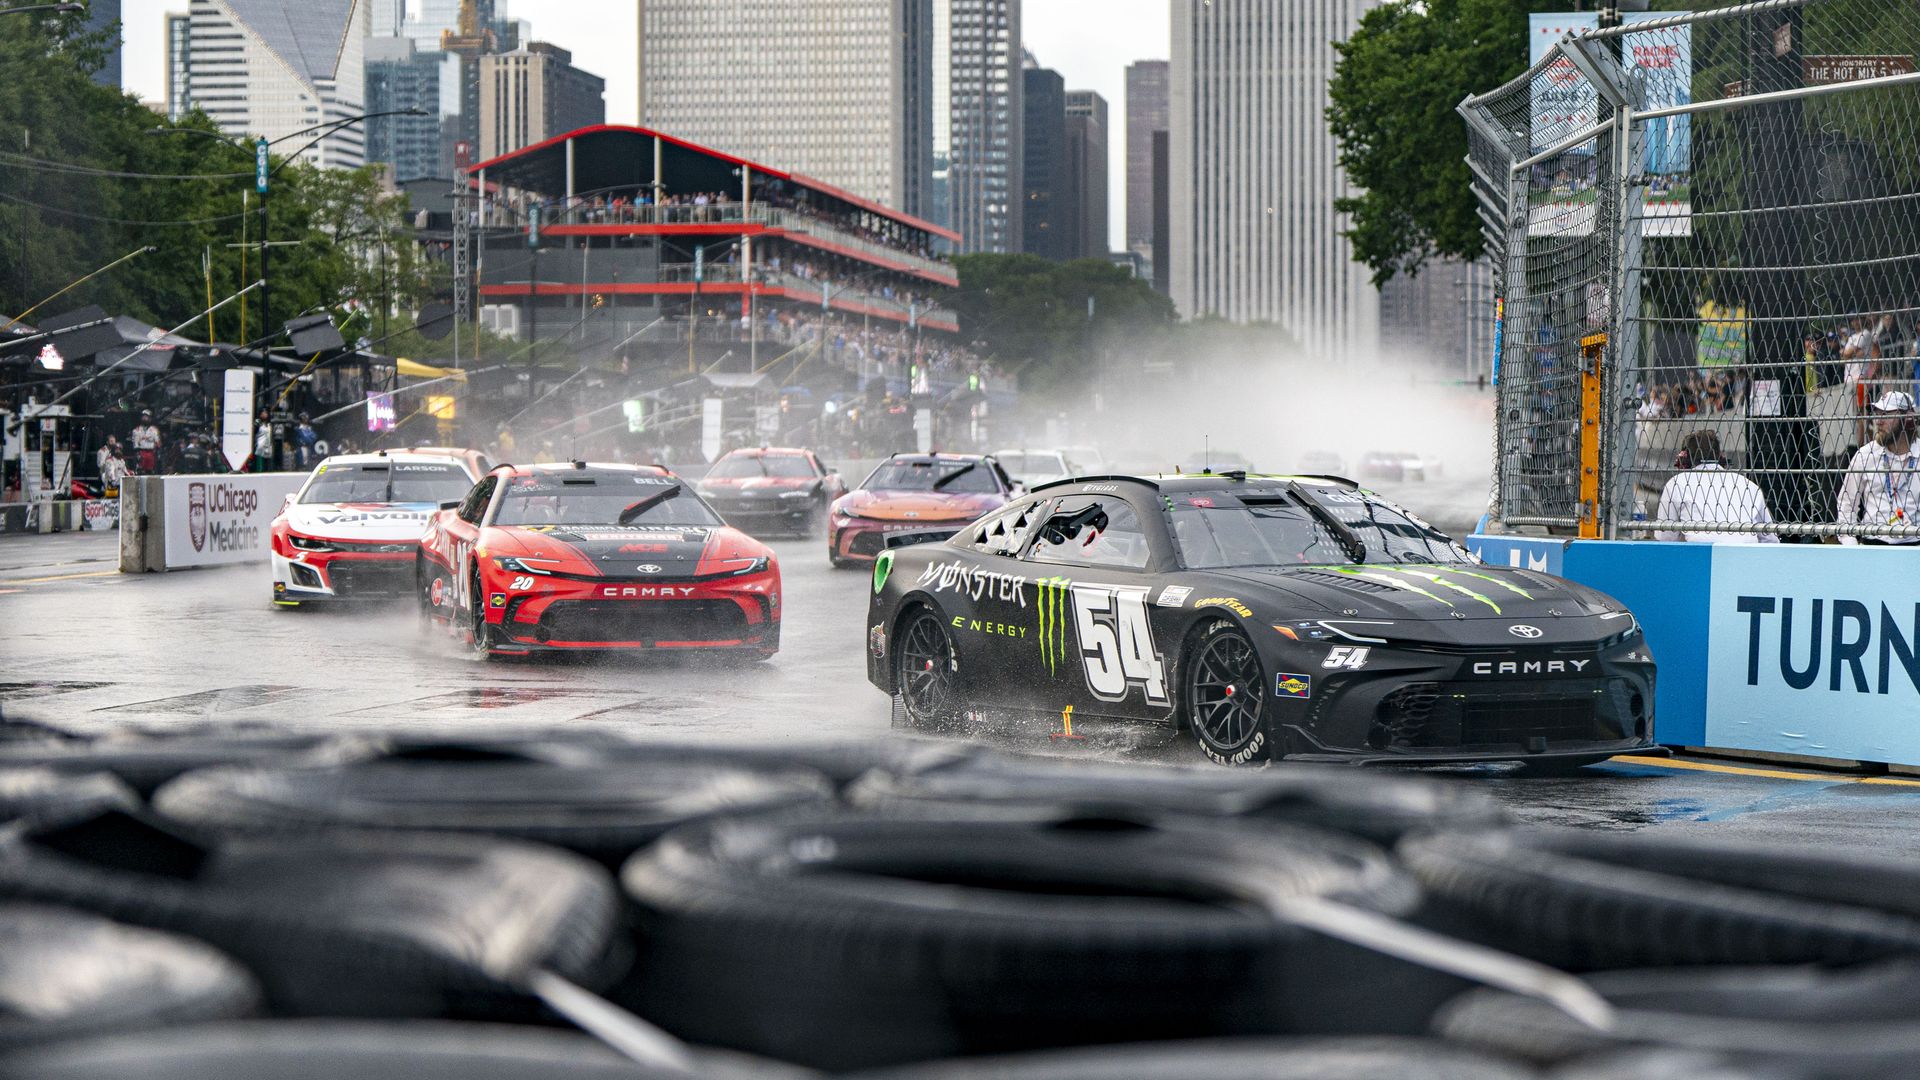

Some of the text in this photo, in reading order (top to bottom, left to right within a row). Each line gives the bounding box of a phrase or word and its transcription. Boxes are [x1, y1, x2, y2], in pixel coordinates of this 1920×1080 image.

[1810, 67, 1829, 79] THE
[1833, 67, 1853, 79] HOT
[1858, 66, 1876, 79] MIX
[633, 478, 674, 486] BELL
[208, 483, 258, 517] UChicago
[317, 512, 428, 524] Valvoli
[209, 520, 258, 552] Medicine
[509, 576, 534, 590] 20
[603, 587, 695, 596] CAMRY
[1195, 597, 1253, 618] GOODYEAR
[952, 616, 1026, 638] ENERGY
[1071, 584, 1170, 706] 54
[1737, 596, 1920, 694] TURN
[1322, 647, 1371, 670] 54
[1473, 659, 1591, 674] CAMRY
[1280, 682, 1308, 691] SUNOCO
